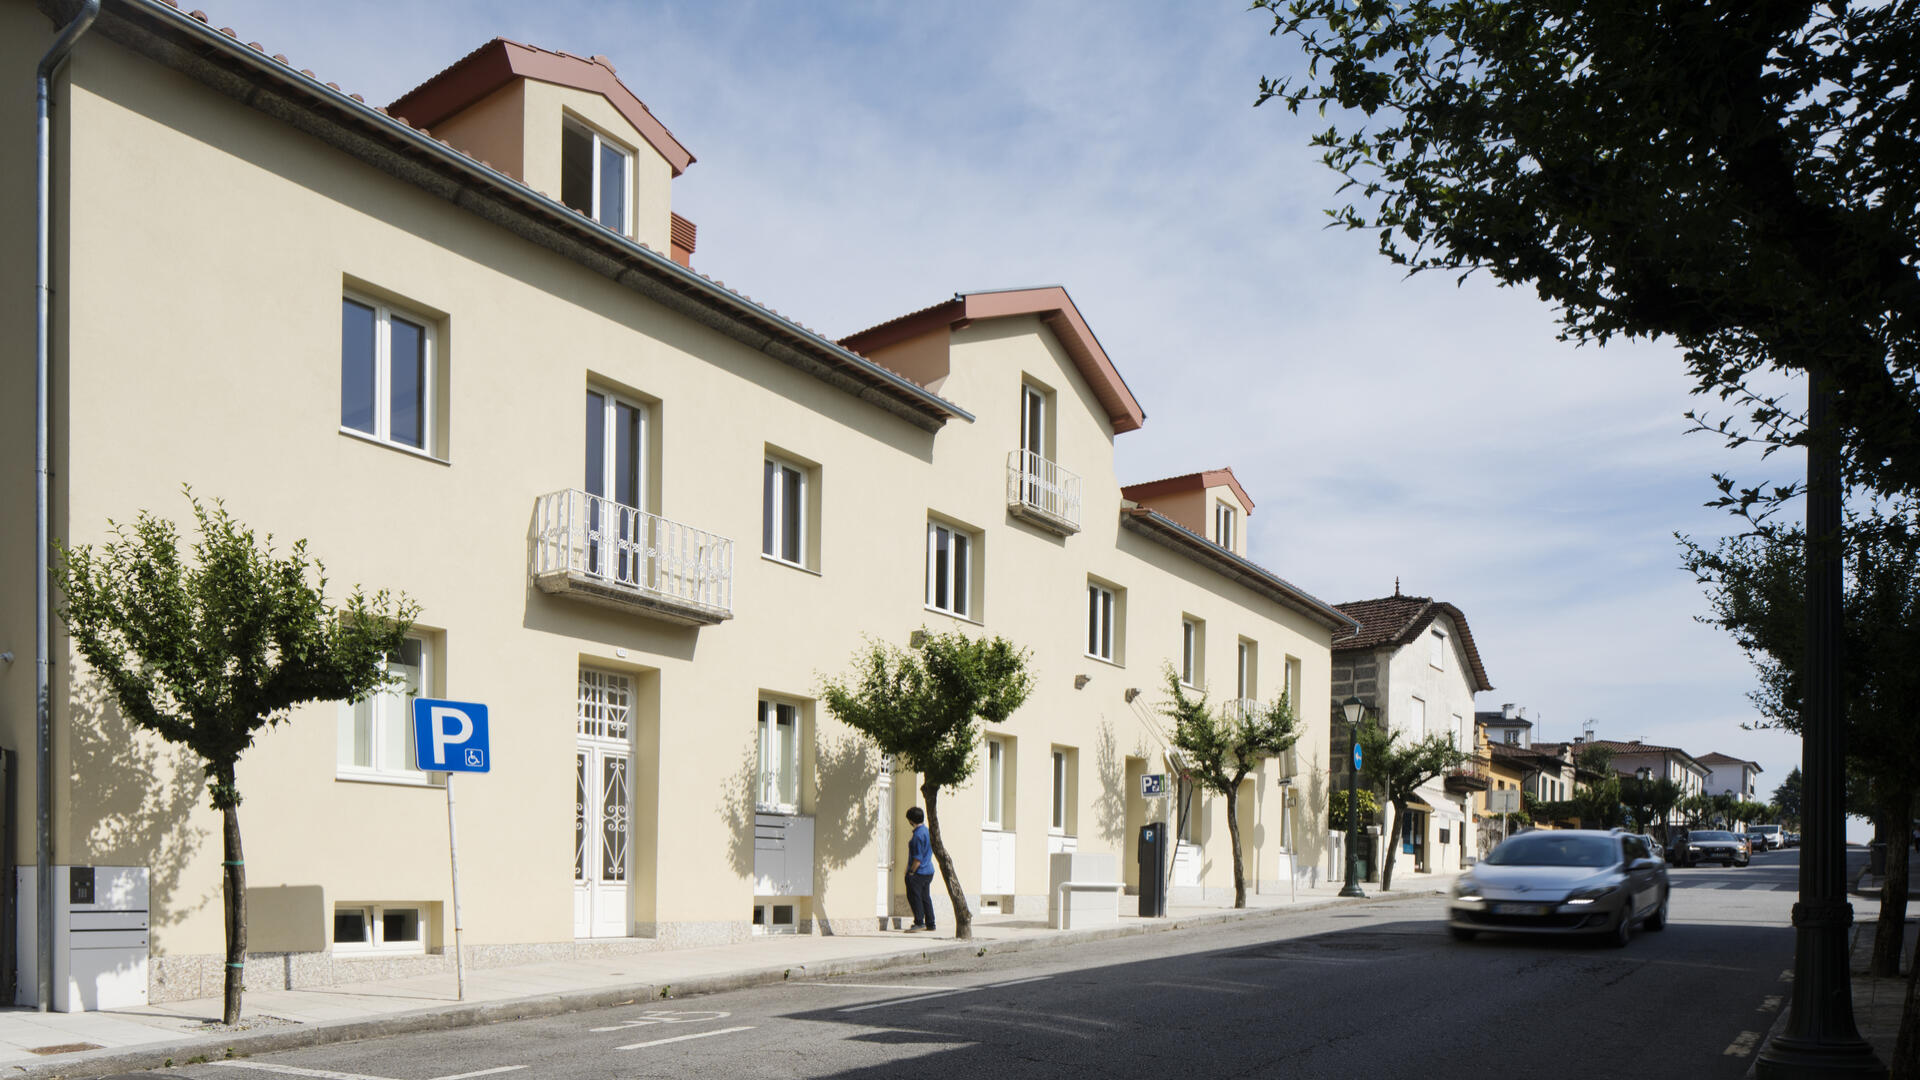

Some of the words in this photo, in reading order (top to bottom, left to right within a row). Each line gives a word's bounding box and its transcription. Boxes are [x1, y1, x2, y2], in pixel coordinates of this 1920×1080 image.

[431, 706, 474, 764] P
[1143, 777, 1153, 793] P
[1146, 830, 1153, 841] P
